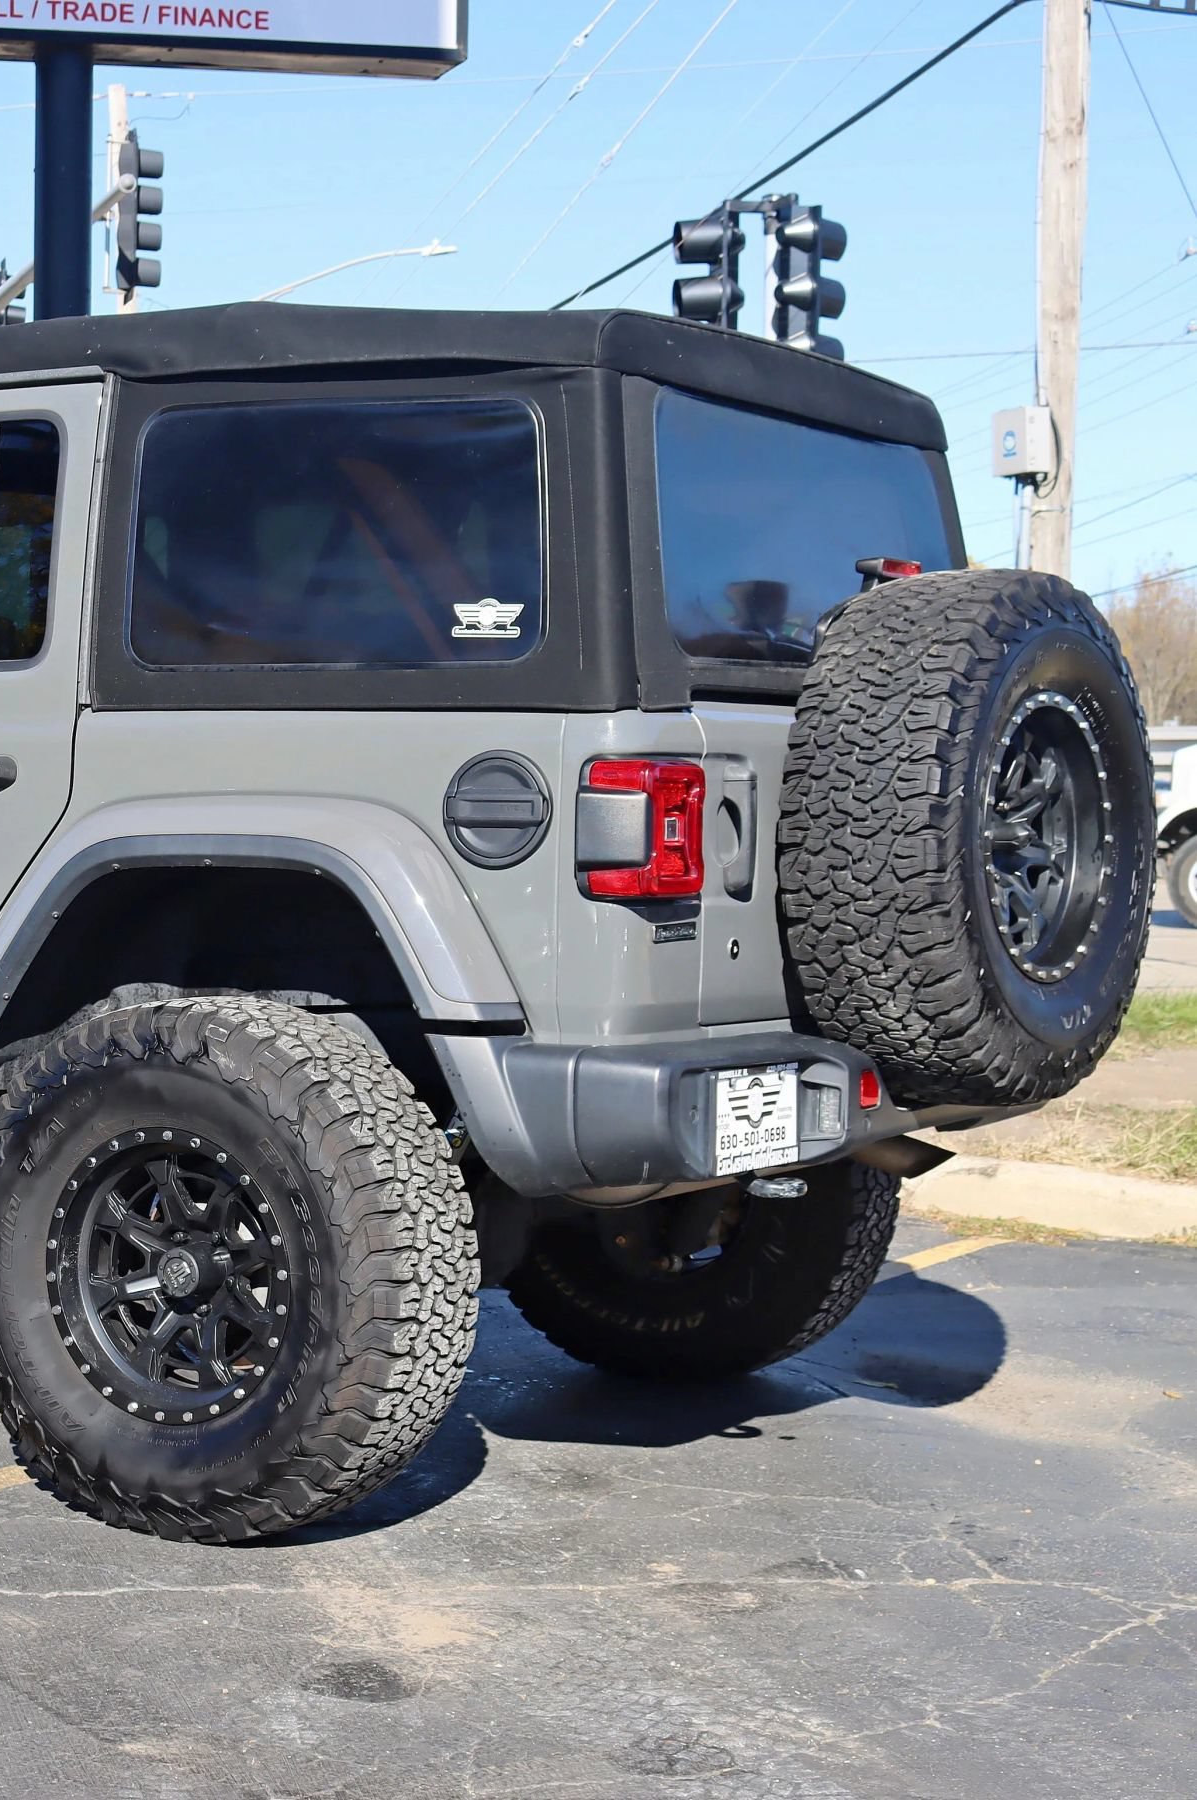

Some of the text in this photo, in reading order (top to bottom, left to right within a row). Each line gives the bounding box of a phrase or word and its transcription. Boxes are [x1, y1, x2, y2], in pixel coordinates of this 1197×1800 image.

[46, 1, 134, 24] TRADE
[158, 6, 269, 30] FINANCE
[720, 1125, 787, 1151] 630-501-0698
